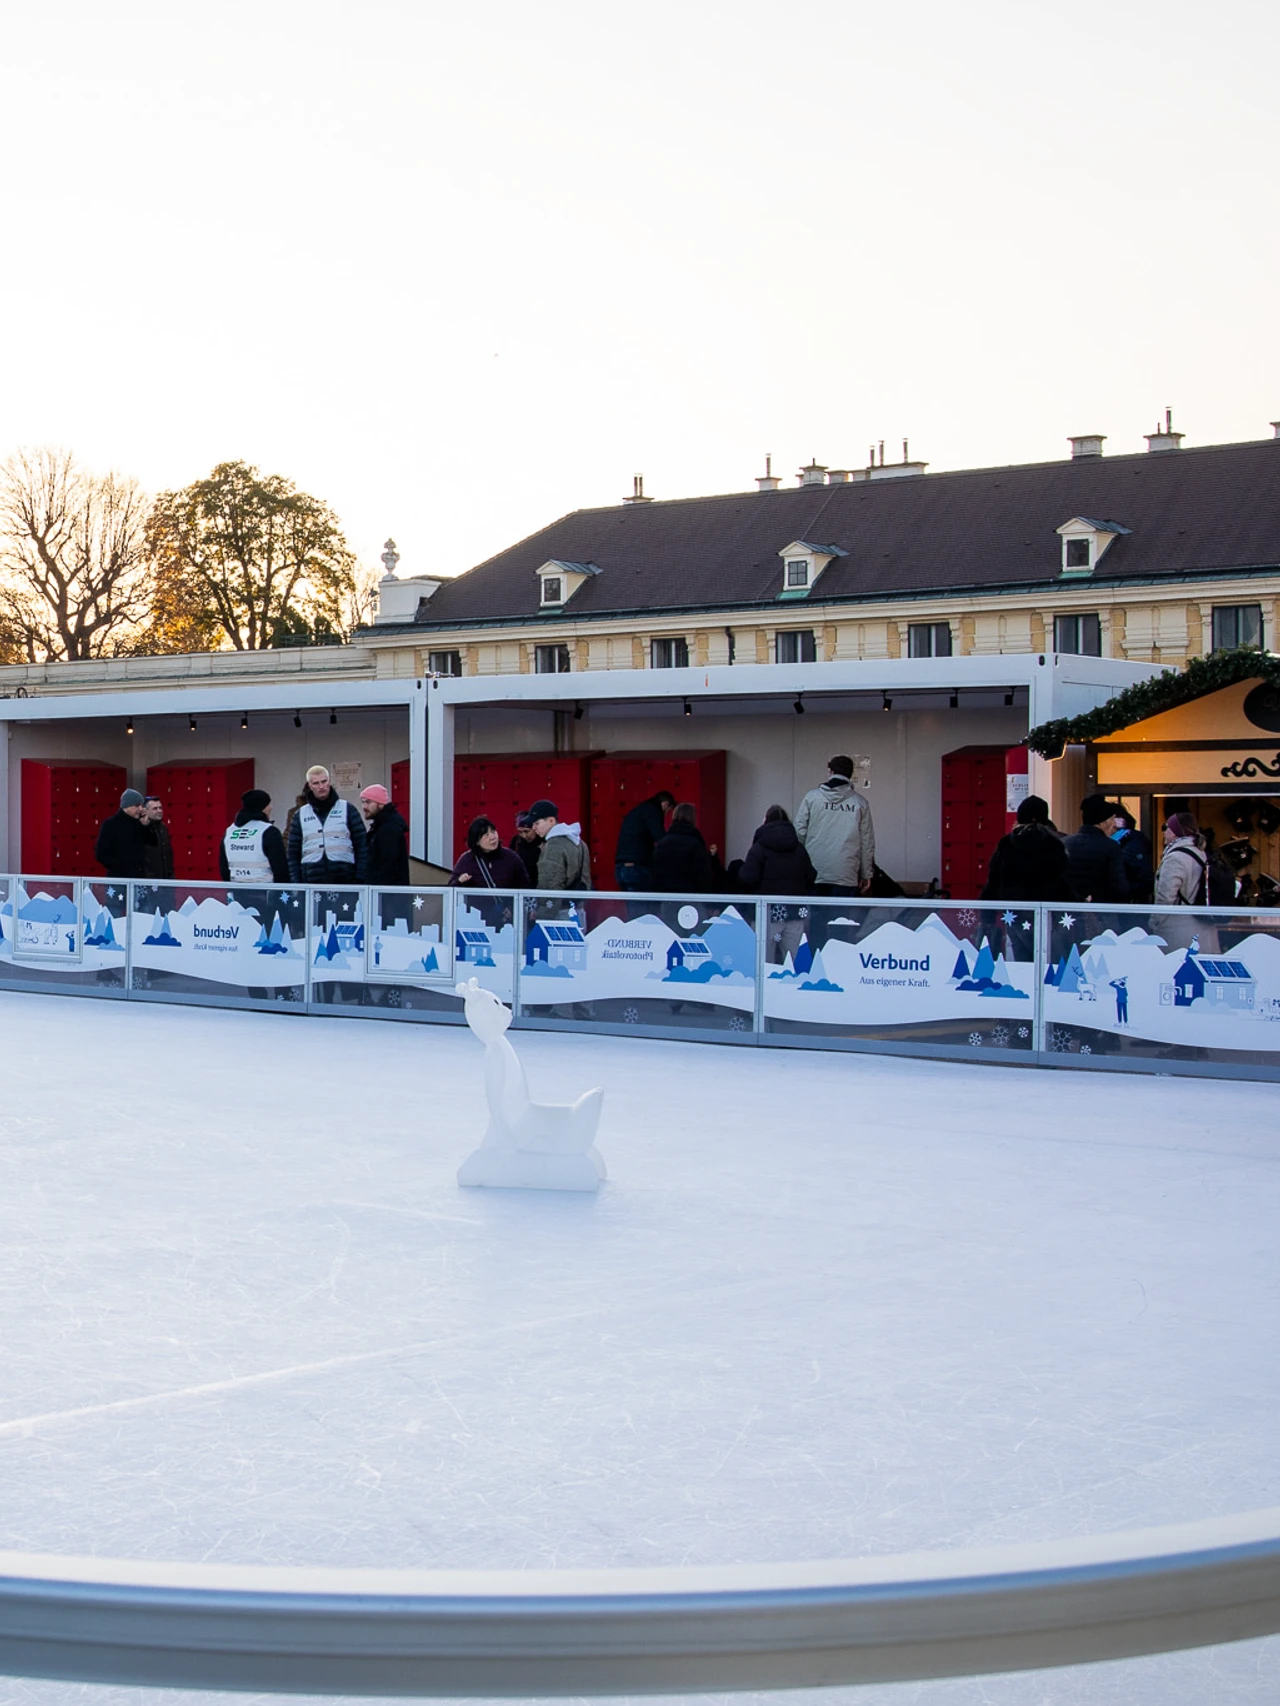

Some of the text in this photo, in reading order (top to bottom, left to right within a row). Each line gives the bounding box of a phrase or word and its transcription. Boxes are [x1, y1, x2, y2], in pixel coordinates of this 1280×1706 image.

[823, 801, 856, 812] TEAM
[859, 953, 931, 971] Verbund
[859, 976, 931, 988] Aus eigener Kraft.
